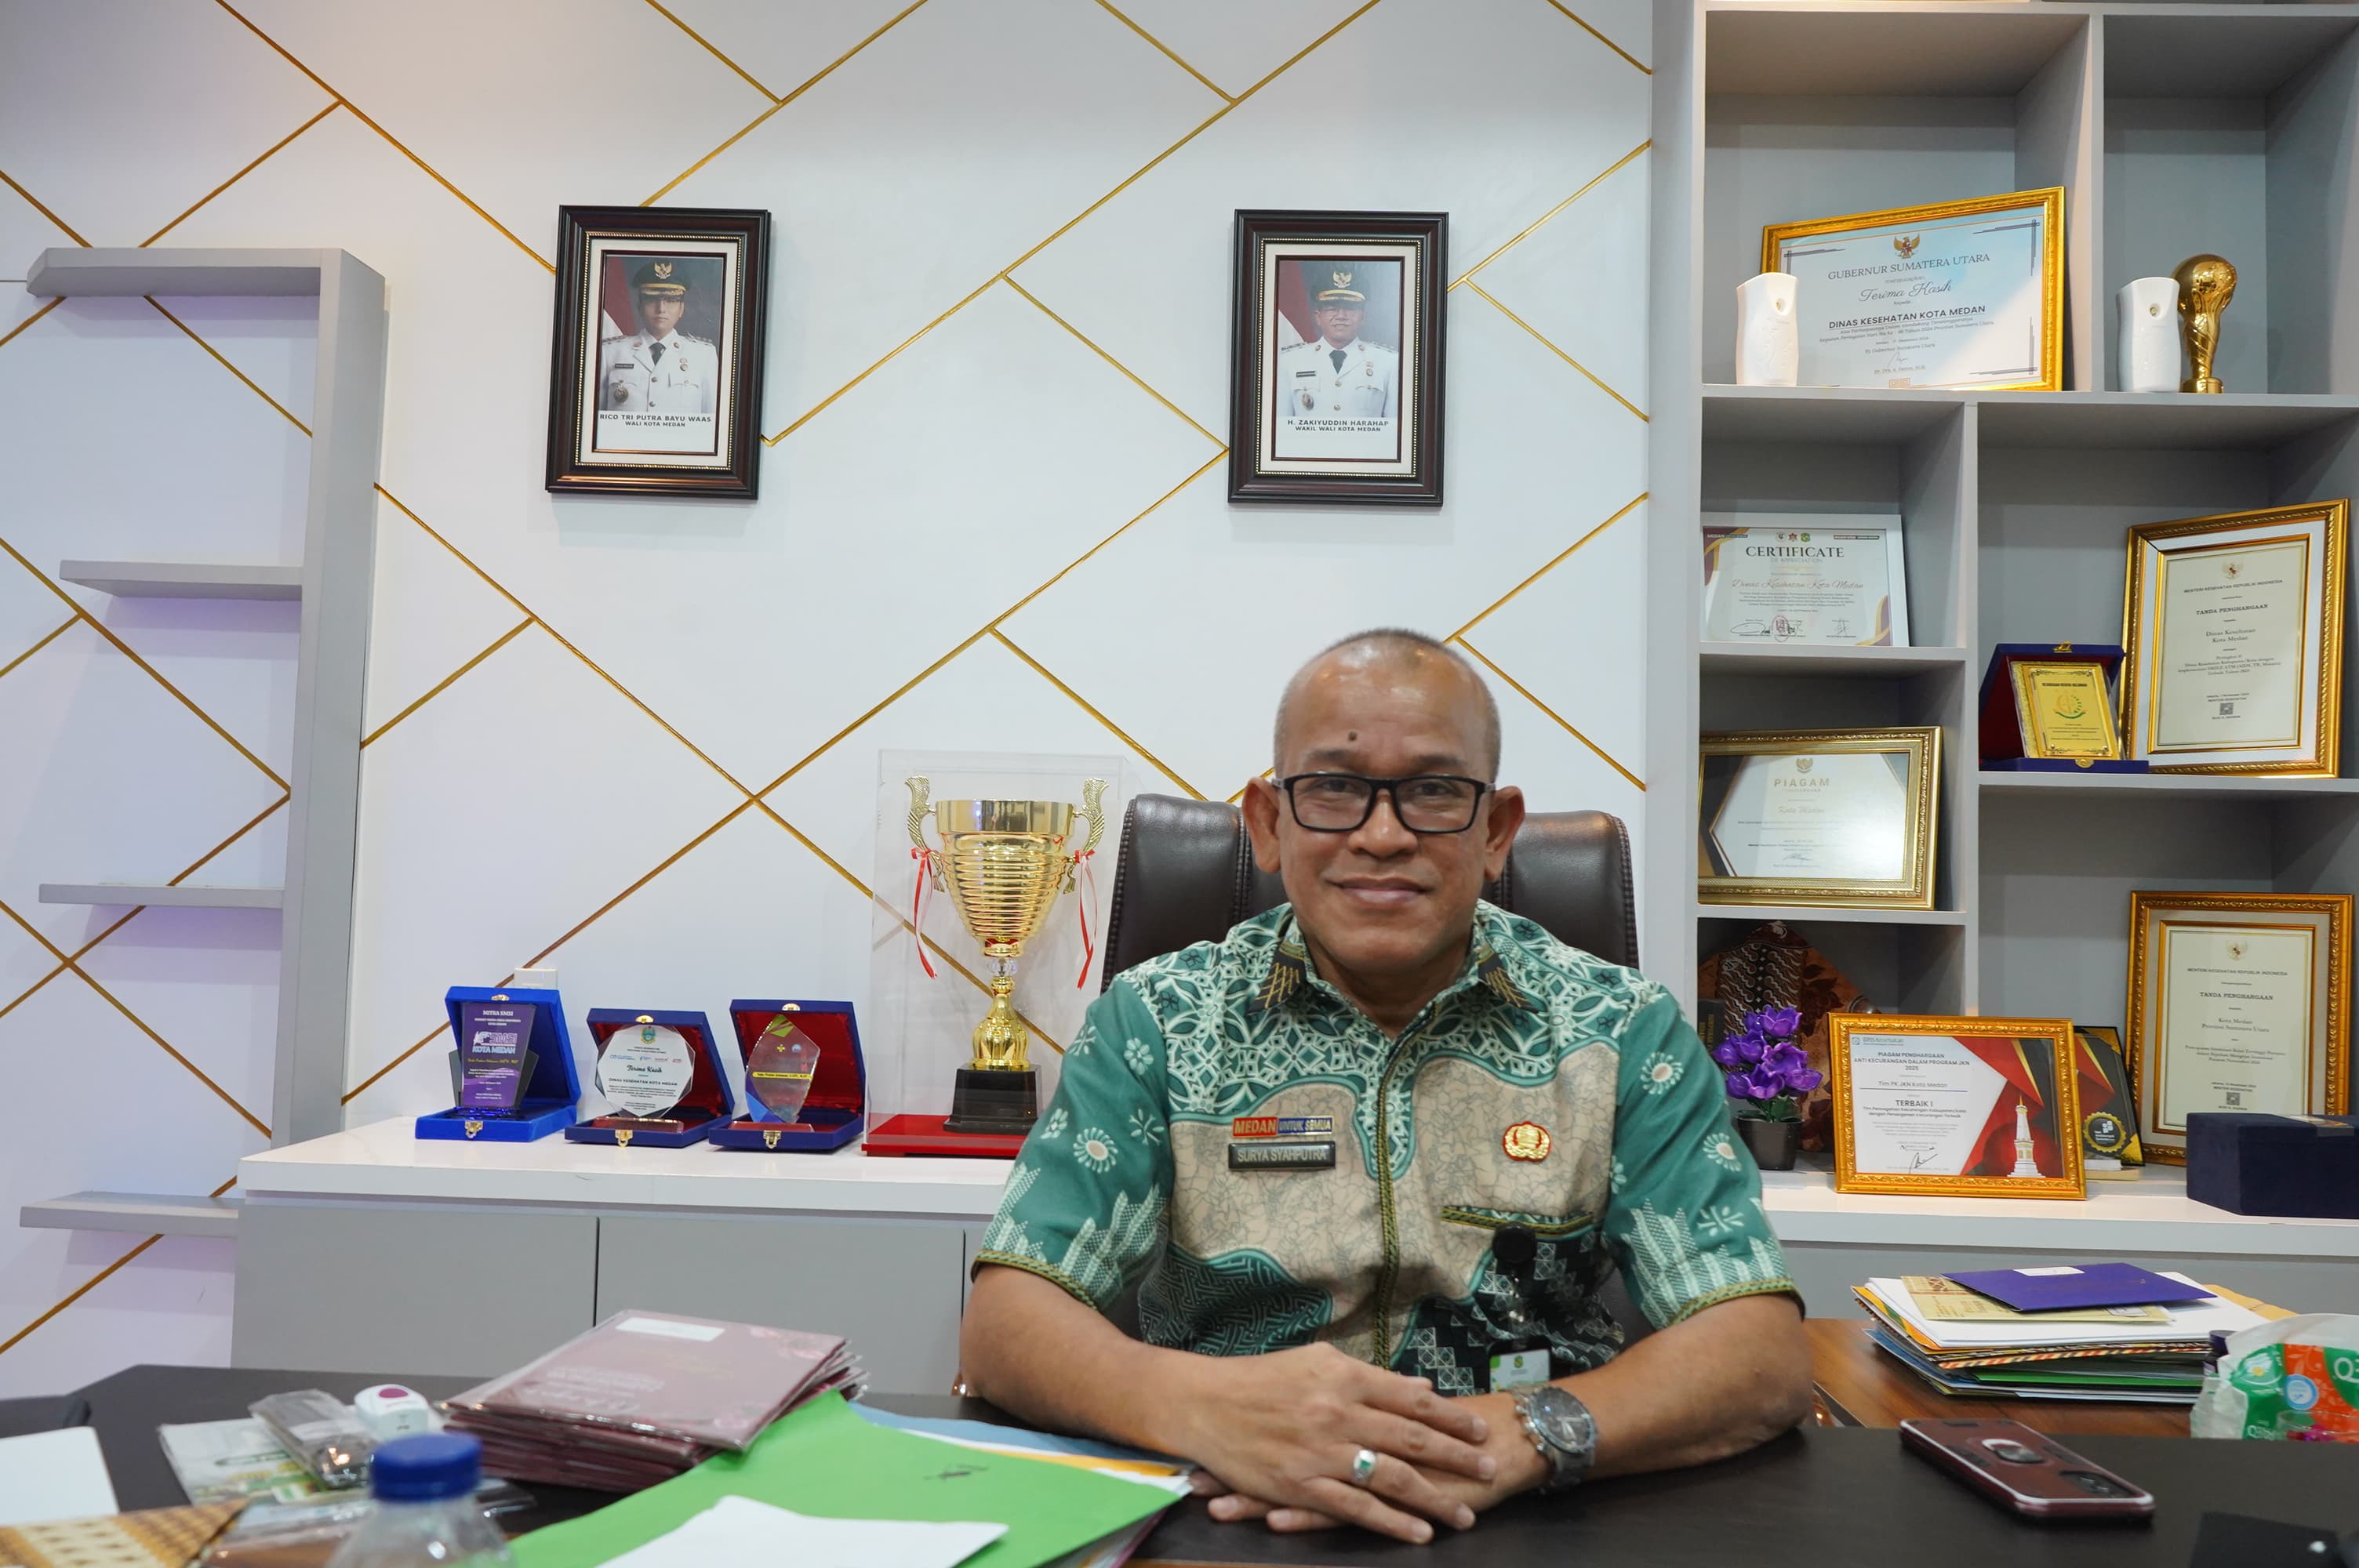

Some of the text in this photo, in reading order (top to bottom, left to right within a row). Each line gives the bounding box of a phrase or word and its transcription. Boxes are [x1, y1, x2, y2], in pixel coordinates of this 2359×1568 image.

[1828, 253, 1990, 280] GUBERNUR SUMATERA UTARA
[1859, 279, 1952, 302] Terima Kasih
[1829, 305, 1986, 328] DINAS KESEHATAN KOTA MEDAN
[1746, 546, 1845, 557] CERTIFICATE
[2219, 604, 2269, 613] PENGHARGAAN
[1774, 777, 1830, 787] PIAGAM
[489, 1032, 518, 1044] SMSI
[1234, 1119, 1332, 1134] MEDAN UNTUK SEMUA
[1238, 1148, 1327, 1163] SURYA SYAHPUTRA
